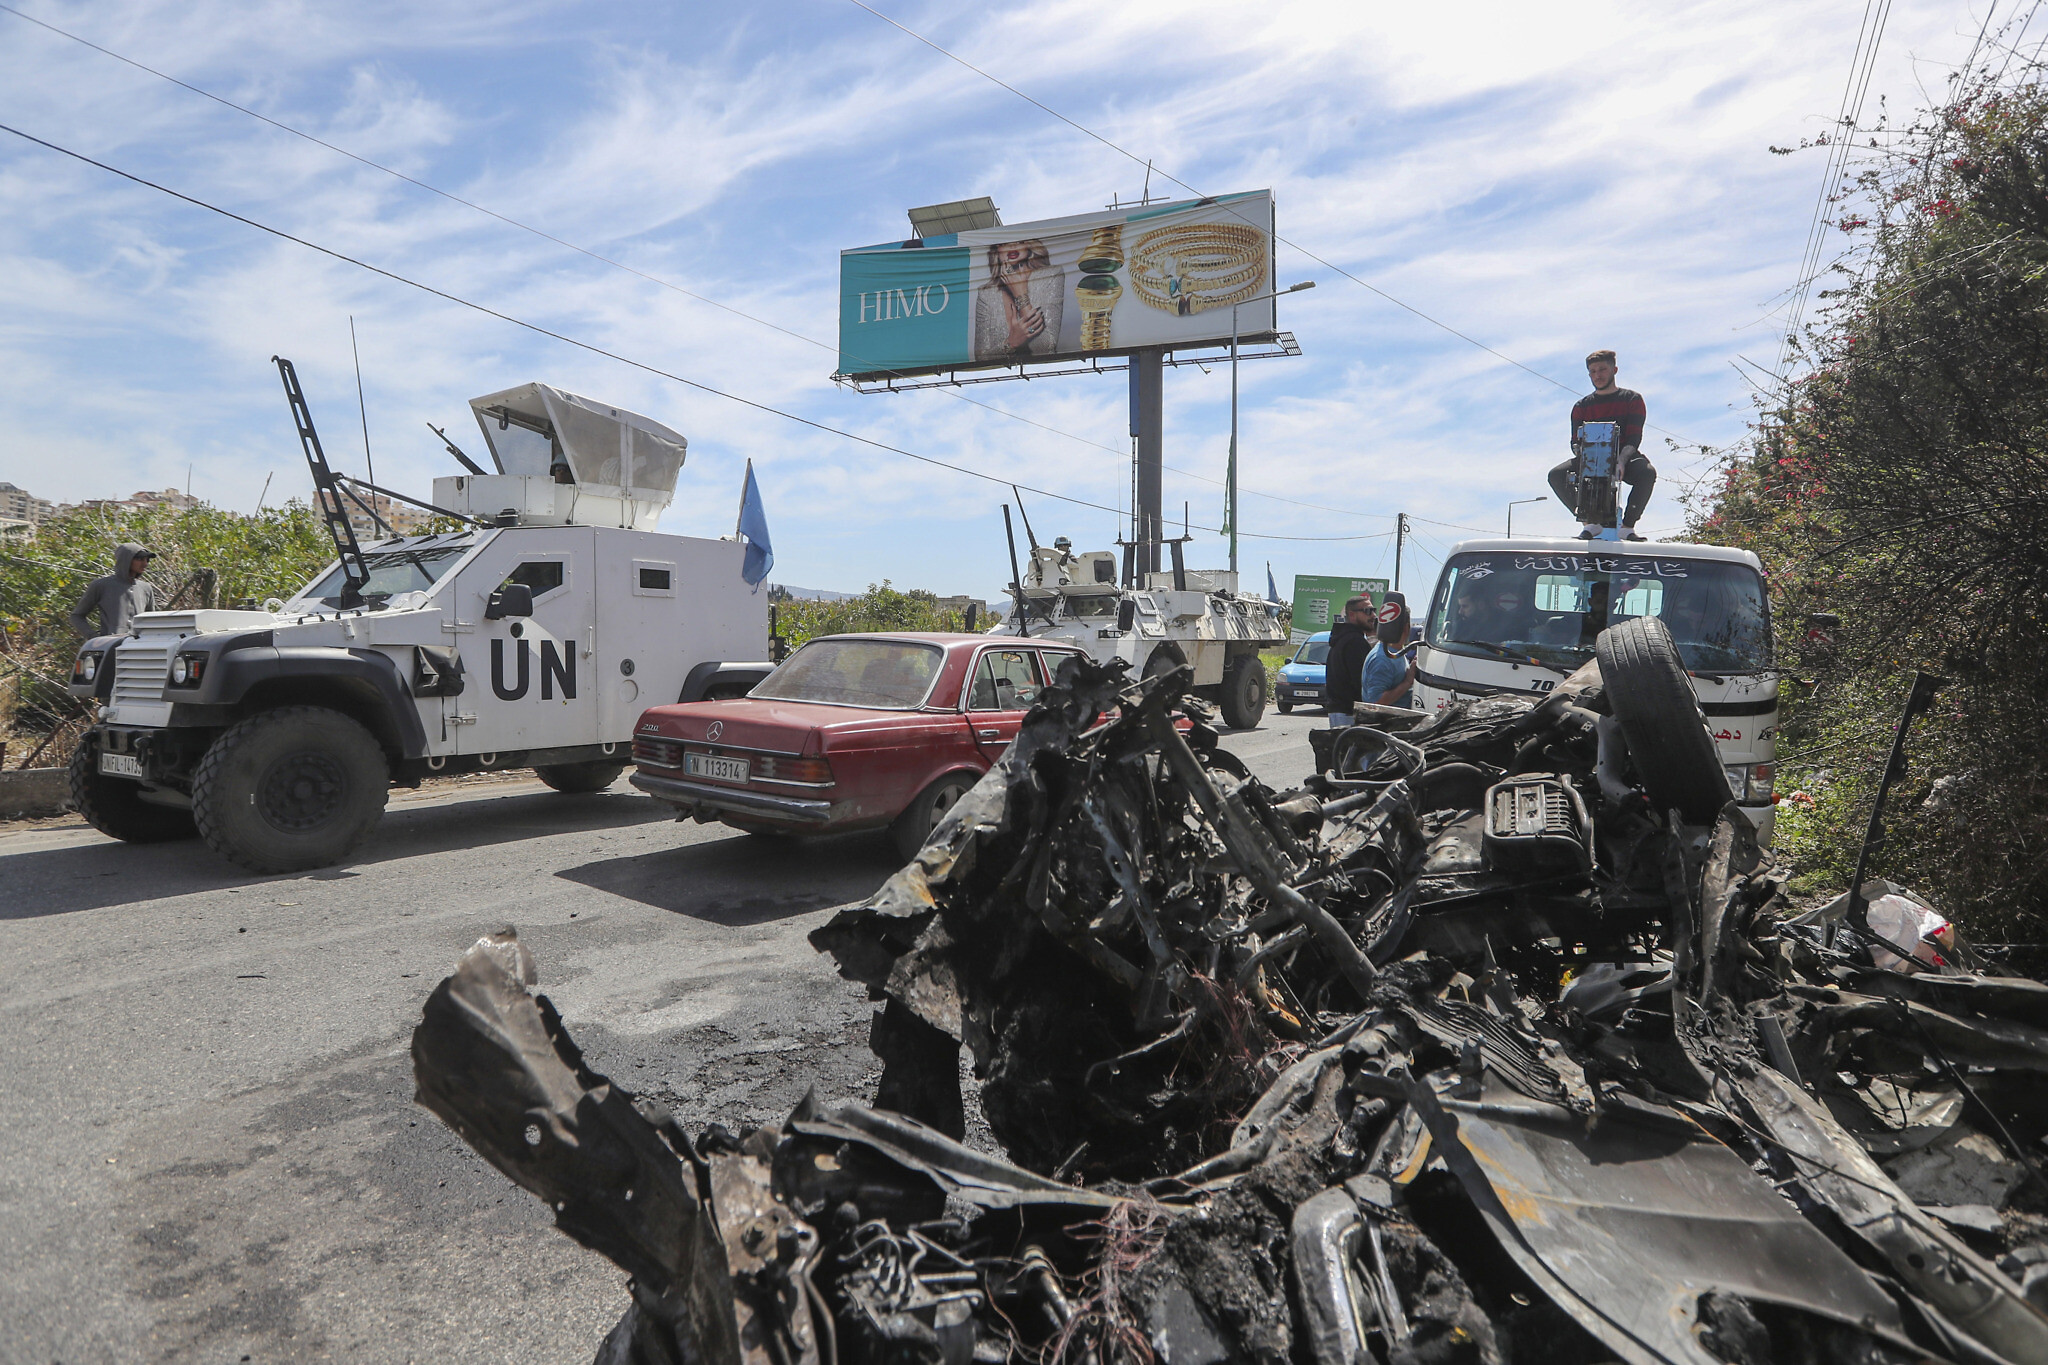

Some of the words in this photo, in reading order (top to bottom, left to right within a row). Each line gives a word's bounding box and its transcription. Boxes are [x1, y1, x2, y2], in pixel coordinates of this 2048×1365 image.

[858, 283, 950, 324] HIMO
[1351, 580, 1385, 593] EDOR
[490, 638, 577, 701] UN
[641, 723, 659, 732] 200
[692, 756, 700, 773] N
[705, 759, 740, 780] 113314
